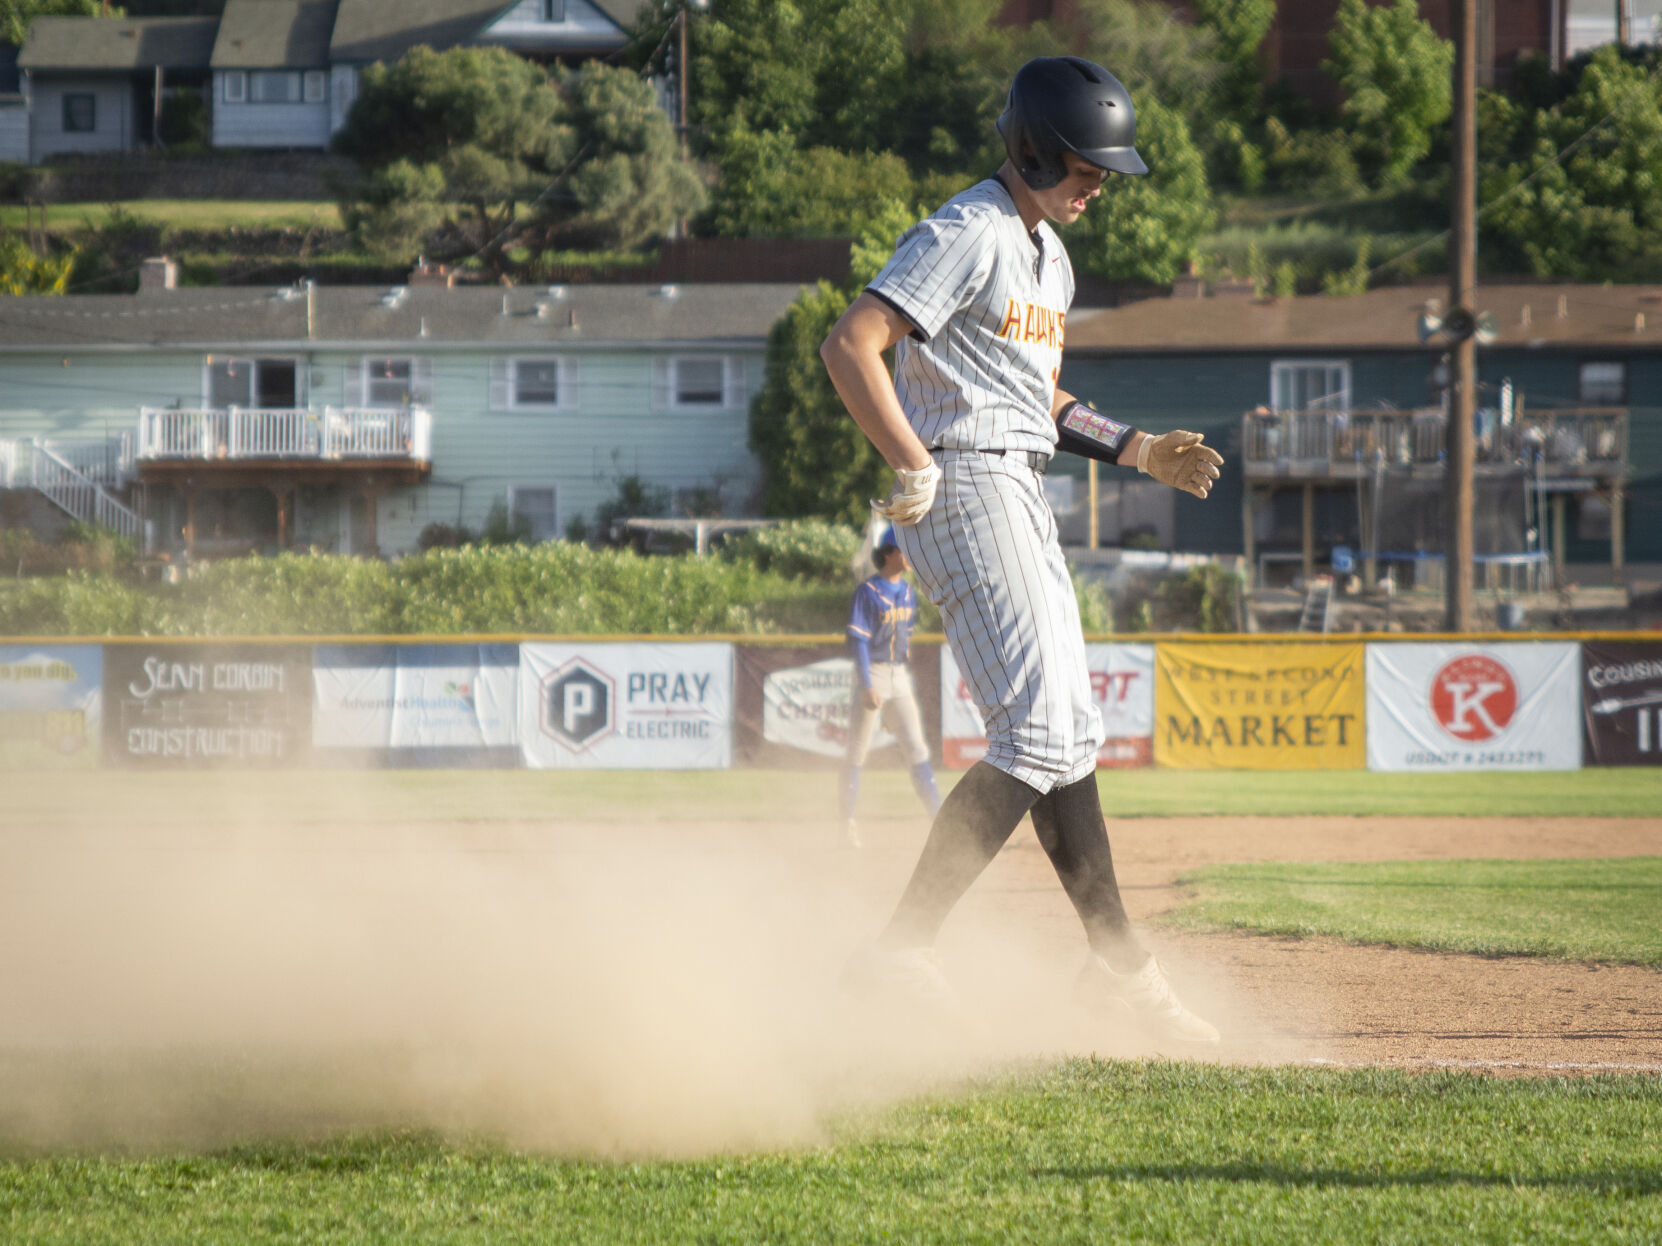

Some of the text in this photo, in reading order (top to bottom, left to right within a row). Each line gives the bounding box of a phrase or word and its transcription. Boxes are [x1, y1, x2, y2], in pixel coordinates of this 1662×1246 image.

[997, 297, 1065, 350] HAWKS
[627, 672, 711, 702] PRAY
[1210, 688, 1308, 705] STREET
[563, 683, 594, 734] P
[1444, 682, 1505, 737] K
[127, 725, 282, 757] CONSTRUCTION
[626, 720, 711, 740] ELECTRIC
[1167, 714, 1355, 747] MARKET
